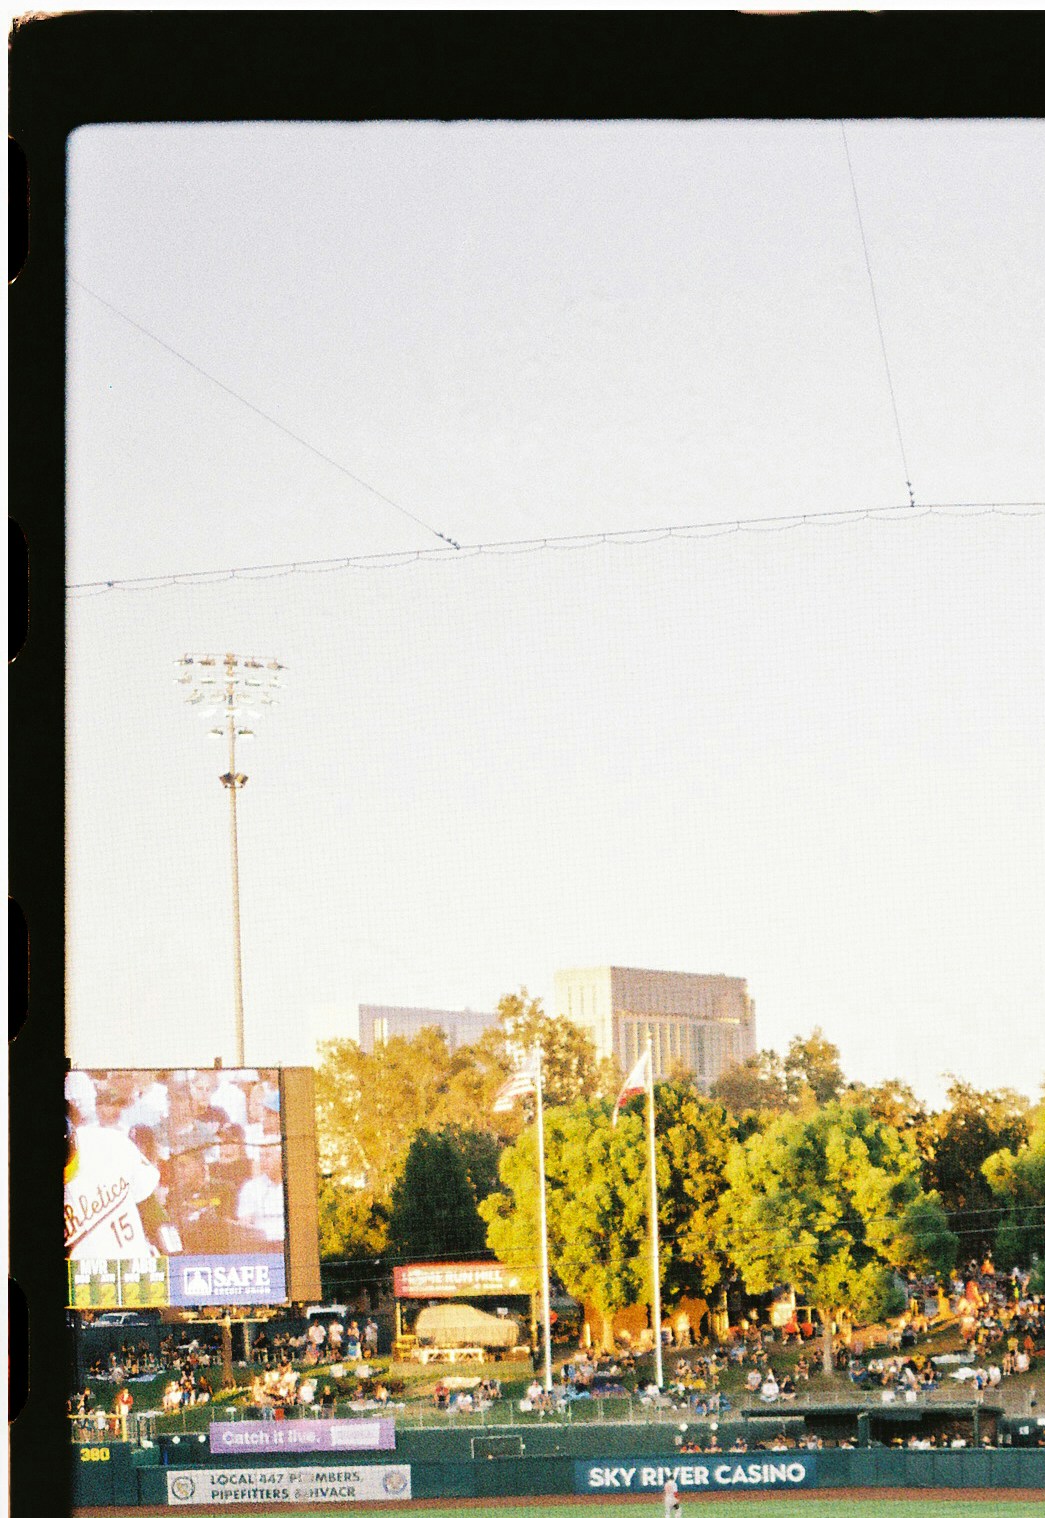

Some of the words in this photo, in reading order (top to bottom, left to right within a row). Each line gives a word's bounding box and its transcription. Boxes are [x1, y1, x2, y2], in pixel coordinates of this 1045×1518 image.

[110, 1213, 134, 1248] 15
[213, 1266, 270, 1286] SAFE
[222, 1430, 270, 1445] Catch
[273, 1430, 284, 1444] it
[210, 1473, 255, 1485] LOCAL
[589, 1467, 636, 1487] SKY
[642, 1466, 710, 1486] RIVER
[714, 1462, 806, 1485] CASINO
[211, 1487, 289, 1500] PIPEFITTERS
